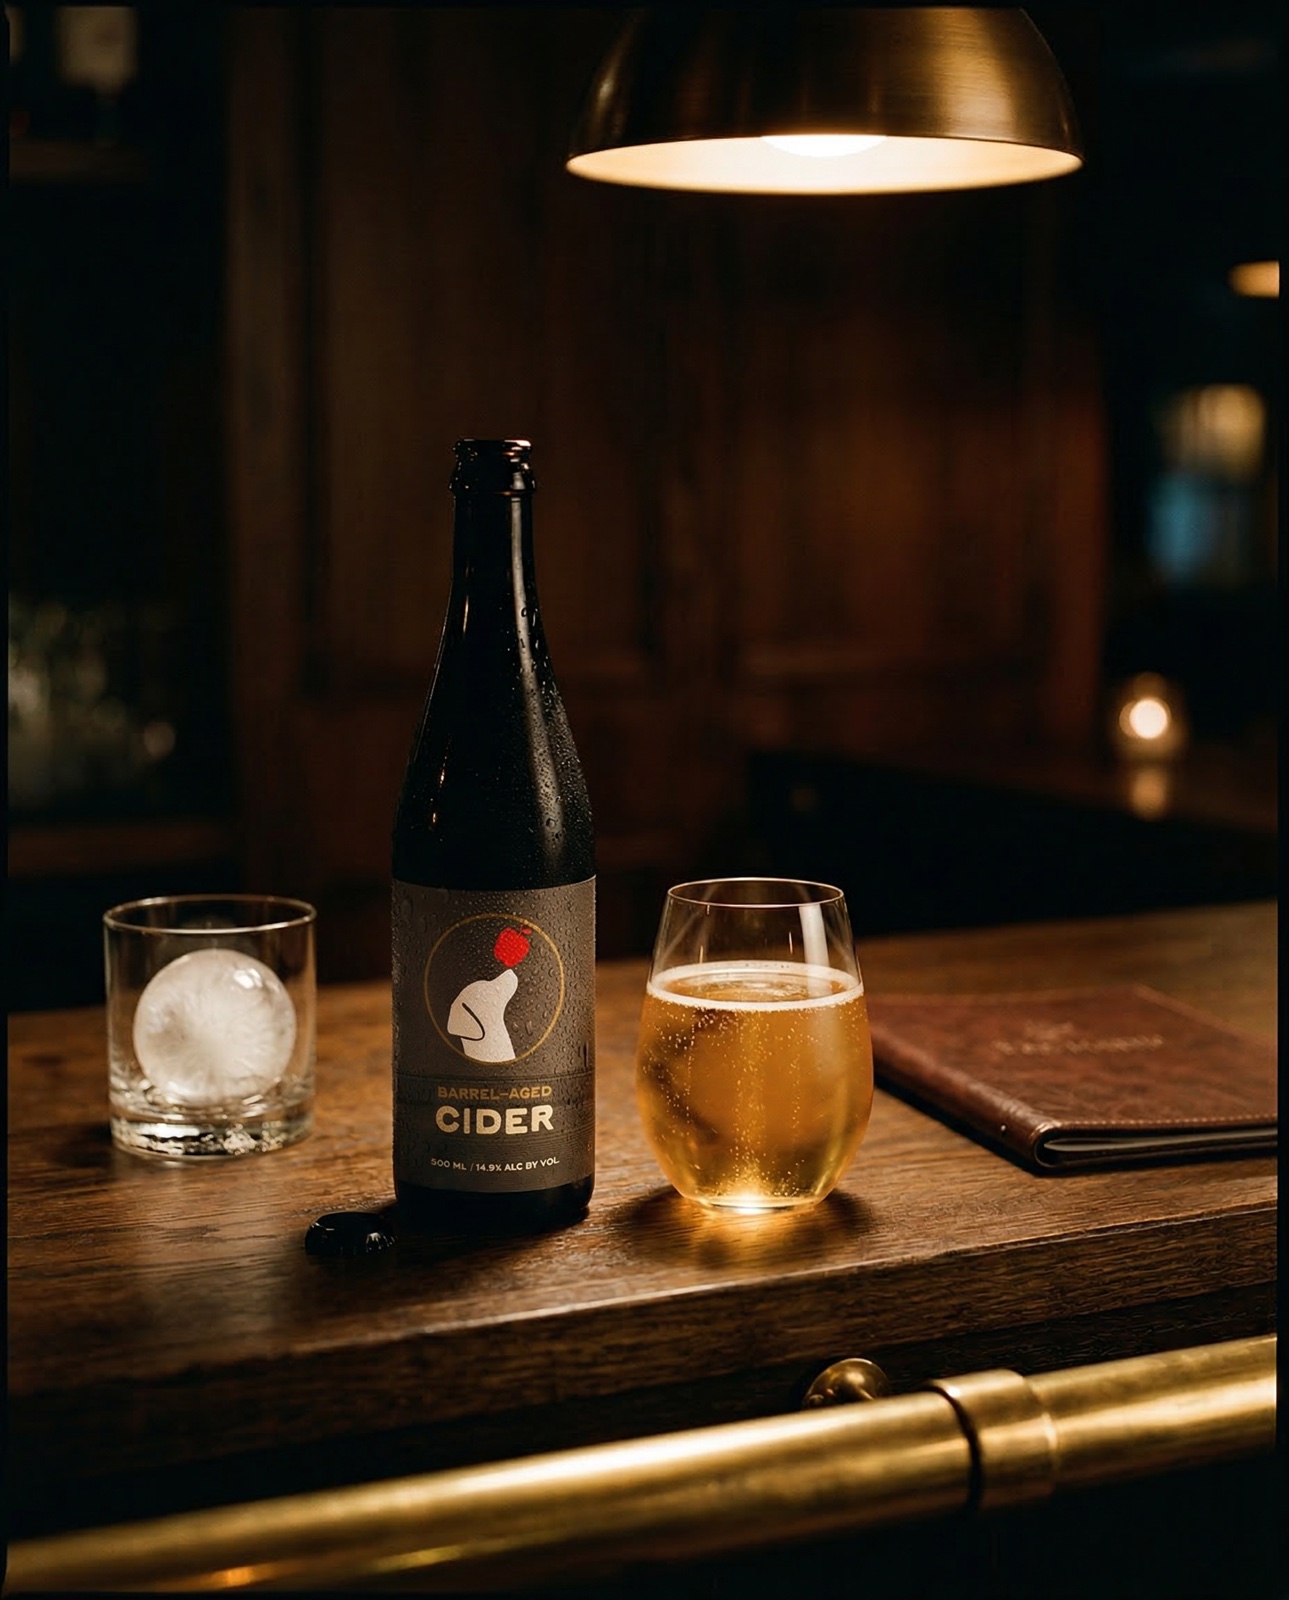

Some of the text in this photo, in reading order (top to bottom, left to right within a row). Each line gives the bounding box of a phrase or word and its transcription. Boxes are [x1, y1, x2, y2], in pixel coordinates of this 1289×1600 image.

[437, 1085, 553, 1100] BARREL-AGED
[435, 1104, 554, 1134] CIDER
[430, 1158, 451, 1168] 500
[452, 1161, 467, 1171] ML
[504, 1162, 523, 1171] ALC
[525, 1160, 539, 1170] BY
[540, 1156, 560, 1167] VOL
